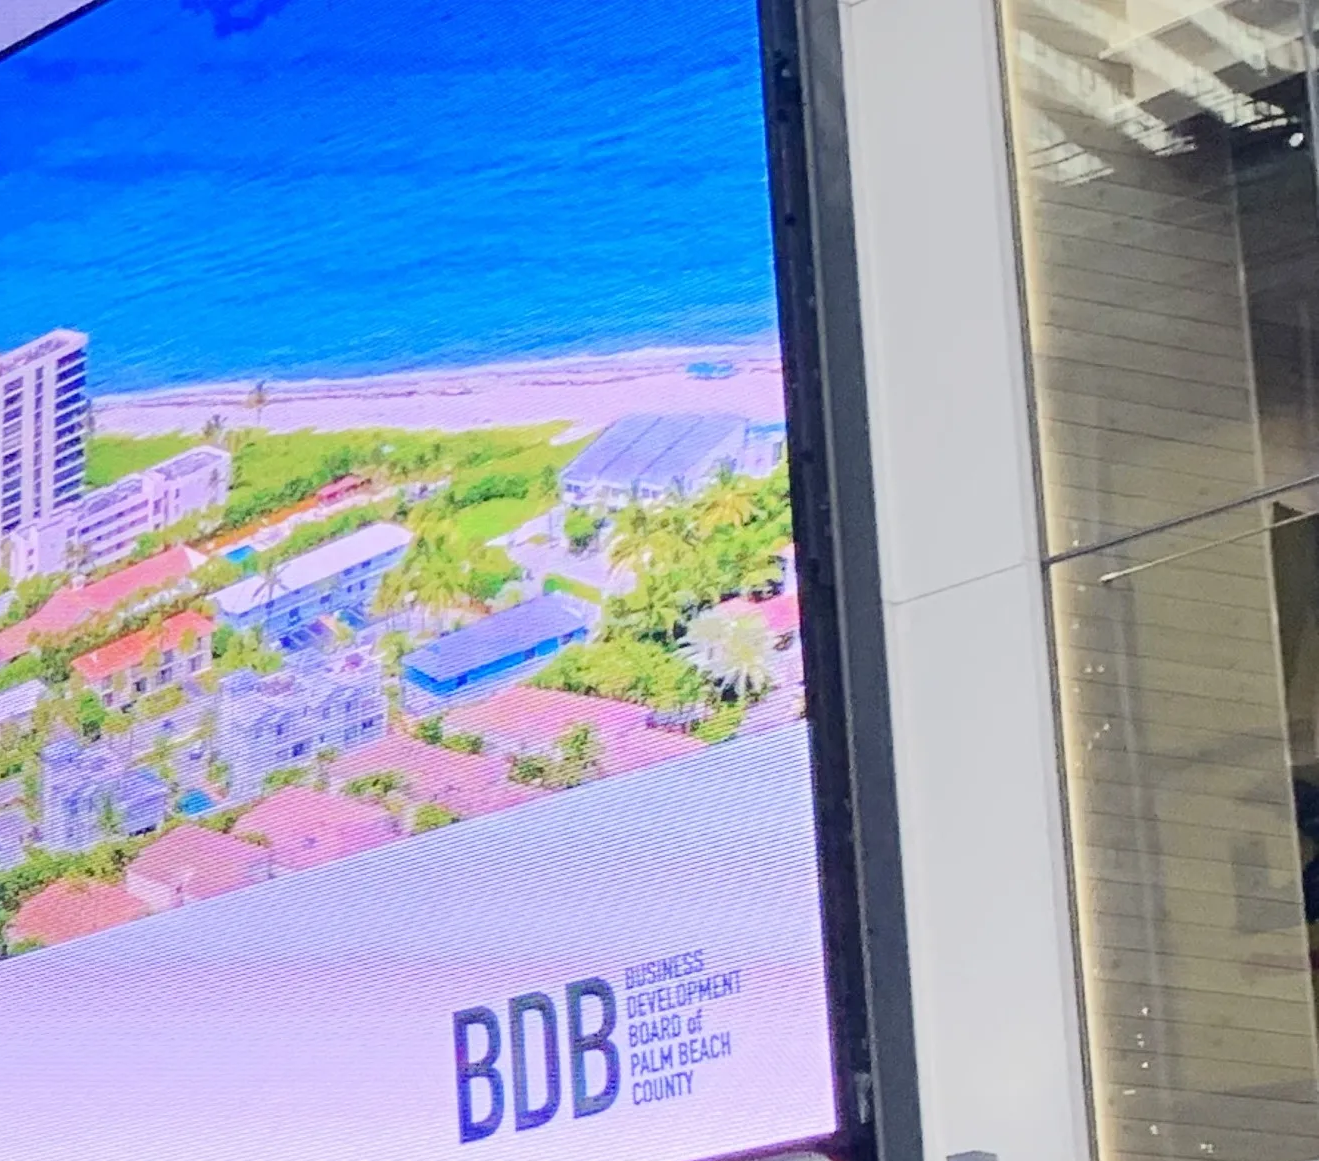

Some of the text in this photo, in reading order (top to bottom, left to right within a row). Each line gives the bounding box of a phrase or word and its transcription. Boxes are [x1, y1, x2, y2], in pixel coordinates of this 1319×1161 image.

[625, 949, 705, 989] BUSINESS
[627, 970, 742, 1018] DEVELOPMENT
[628, 1009, 703, 1047] BOARD of
[453, 976, 621, 1144] BDB
[631, 1031, 731, 1076] PALM BEACH
[632, 1070, 694, 1105] COUNTY
